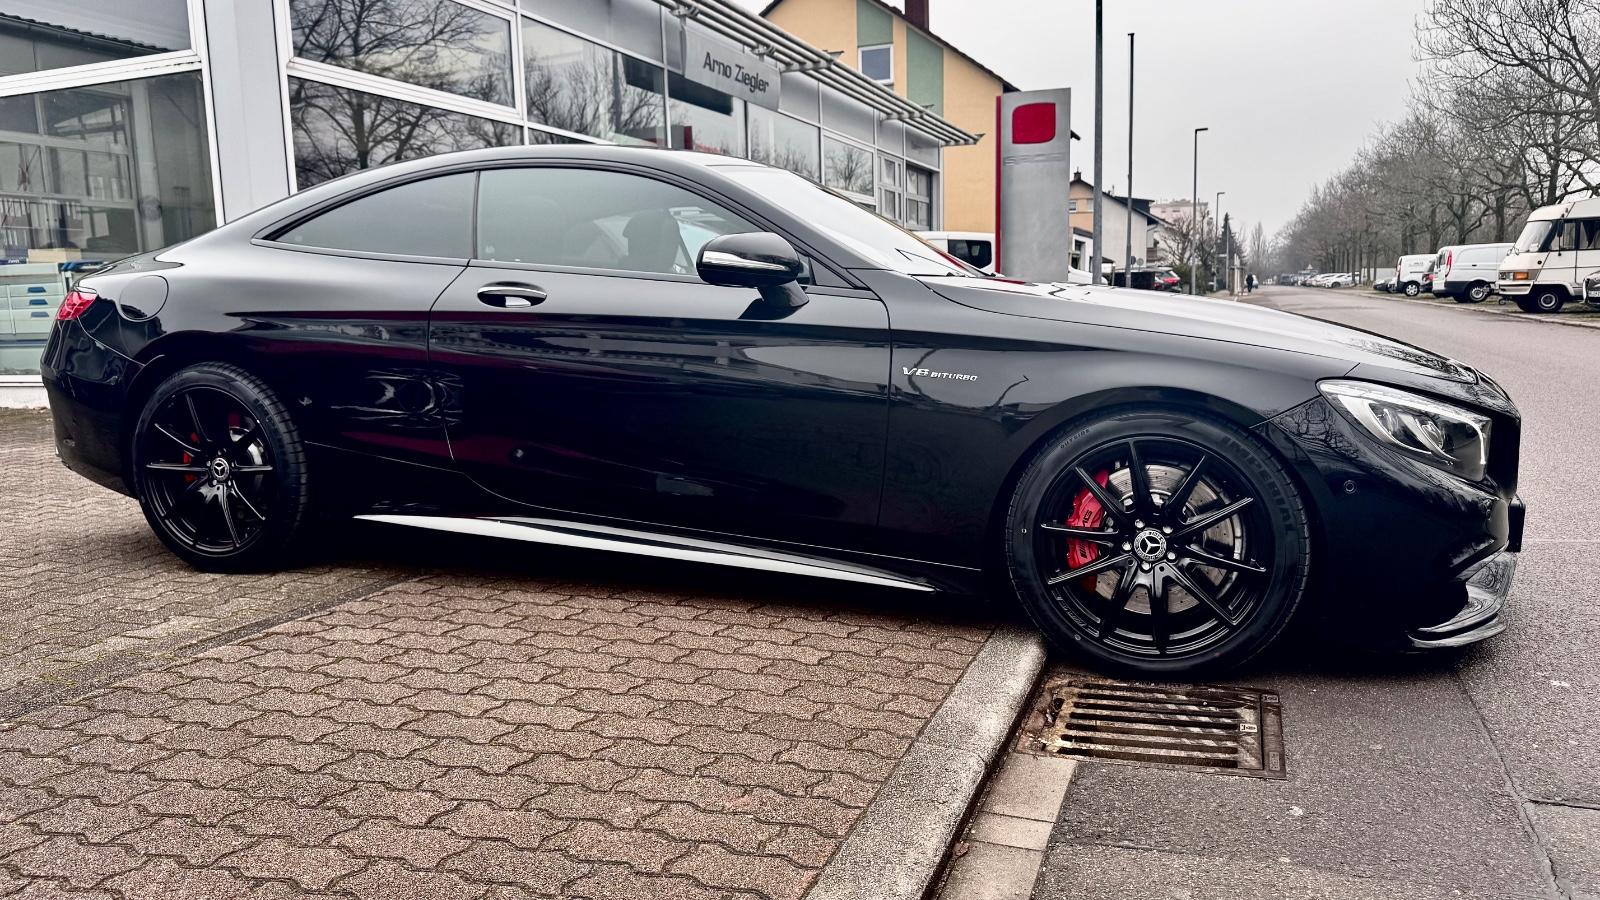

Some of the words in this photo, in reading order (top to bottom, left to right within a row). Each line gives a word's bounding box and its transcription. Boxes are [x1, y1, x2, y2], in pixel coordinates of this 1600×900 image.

[703, 51, 732, 79] Arno
[734, 63, 769, 93] Ziegler
[930, 371, 978, 382] BITURBO
[1060, 428, 1089, 449] OUTSIDE
